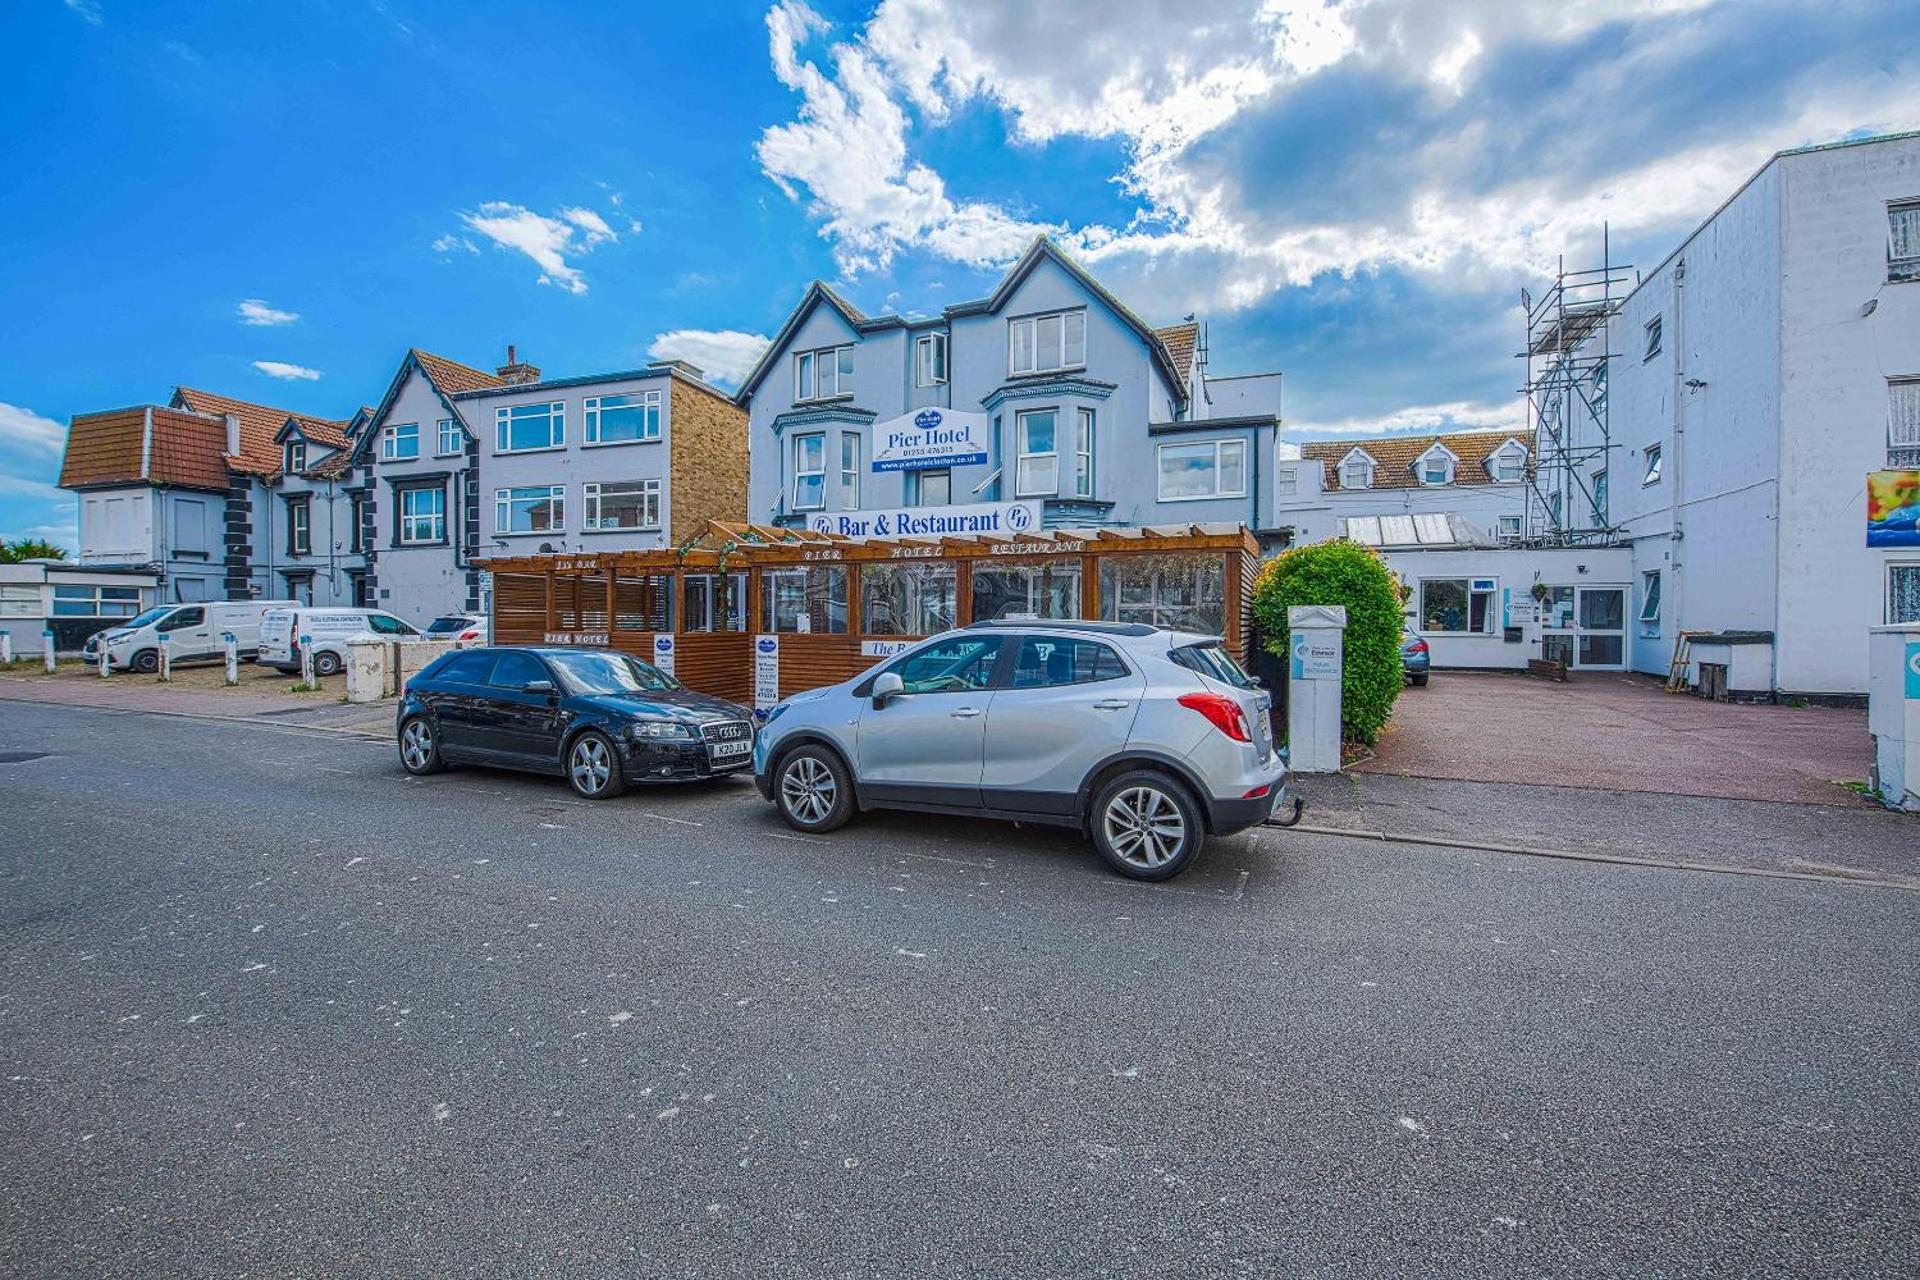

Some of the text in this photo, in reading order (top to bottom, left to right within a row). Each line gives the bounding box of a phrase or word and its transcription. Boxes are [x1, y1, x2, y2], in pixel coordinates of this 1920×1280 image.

[889, 426, 970, 448] Pier Hotel
[903, 446, 953, 457] 01255 476315
[839, 508, 1000, 536] Bar & Restaurant
[804, 540, 1084, 560] PIER HOTEL RESTAURANT
[871, 642, 893, 655] The
